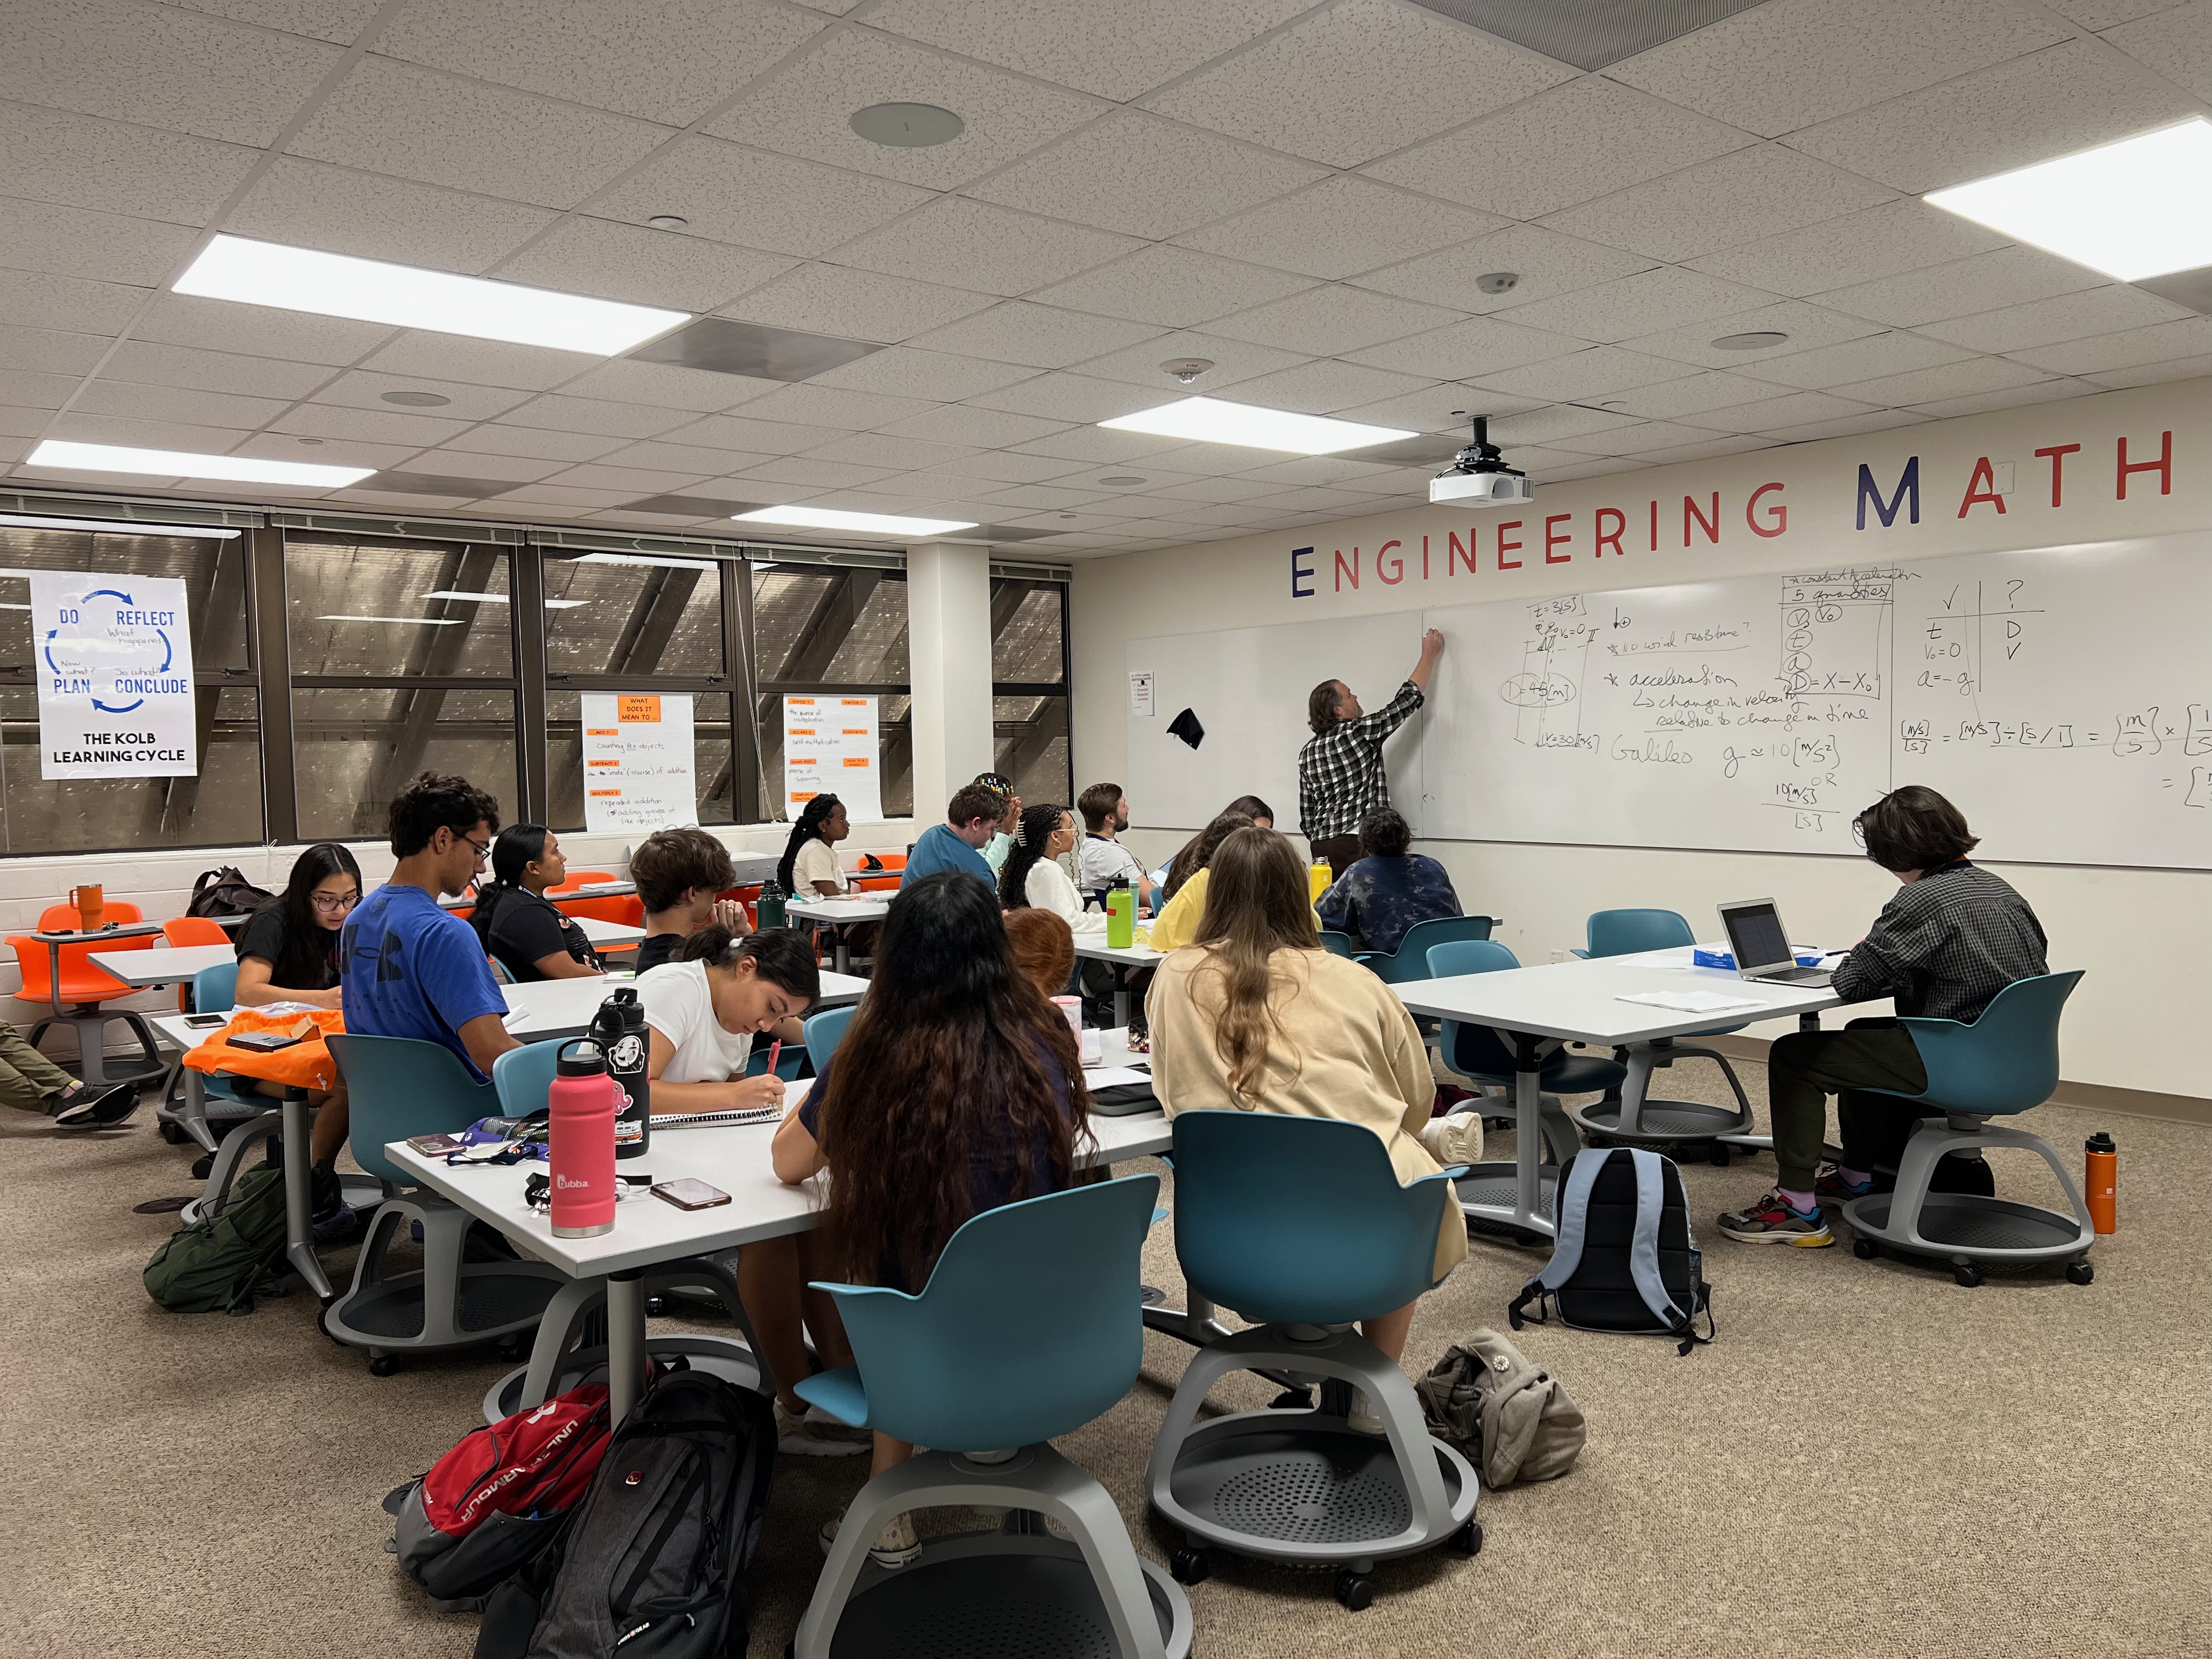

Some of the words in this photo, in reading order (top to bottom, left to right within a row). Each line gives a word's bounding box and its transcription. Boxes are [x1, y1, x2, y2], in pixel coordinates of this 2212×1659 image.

[1291, 482, 1788, 599] ENGINEERING
[1856, 430, 2172, 531] MATH
[1792, 589, 1804, 601] 5
[60, 609, 79, 624] DO
[116, 610, 175, 626] REFLECT
[107, 627, 135, 637] What
[65, 666, 96, 675] what?
[115, 667, 128, 676] So
[54, 678, 91, 694] PLAN
[115, 679, 188, 694] CONCLUDE
[83, 732, 112, 745] THE
[114, 732, 156, 745] KOLB
[639, 742, 665, 751] objects
[1611, 734, 1693, 764] Galileo
[53, 750, 133, 763] LEARNING
[135, 749, 186, 762] CYCLE
[600, 799, 630, 808] repeated
[646, 809, 665, 817] groups
